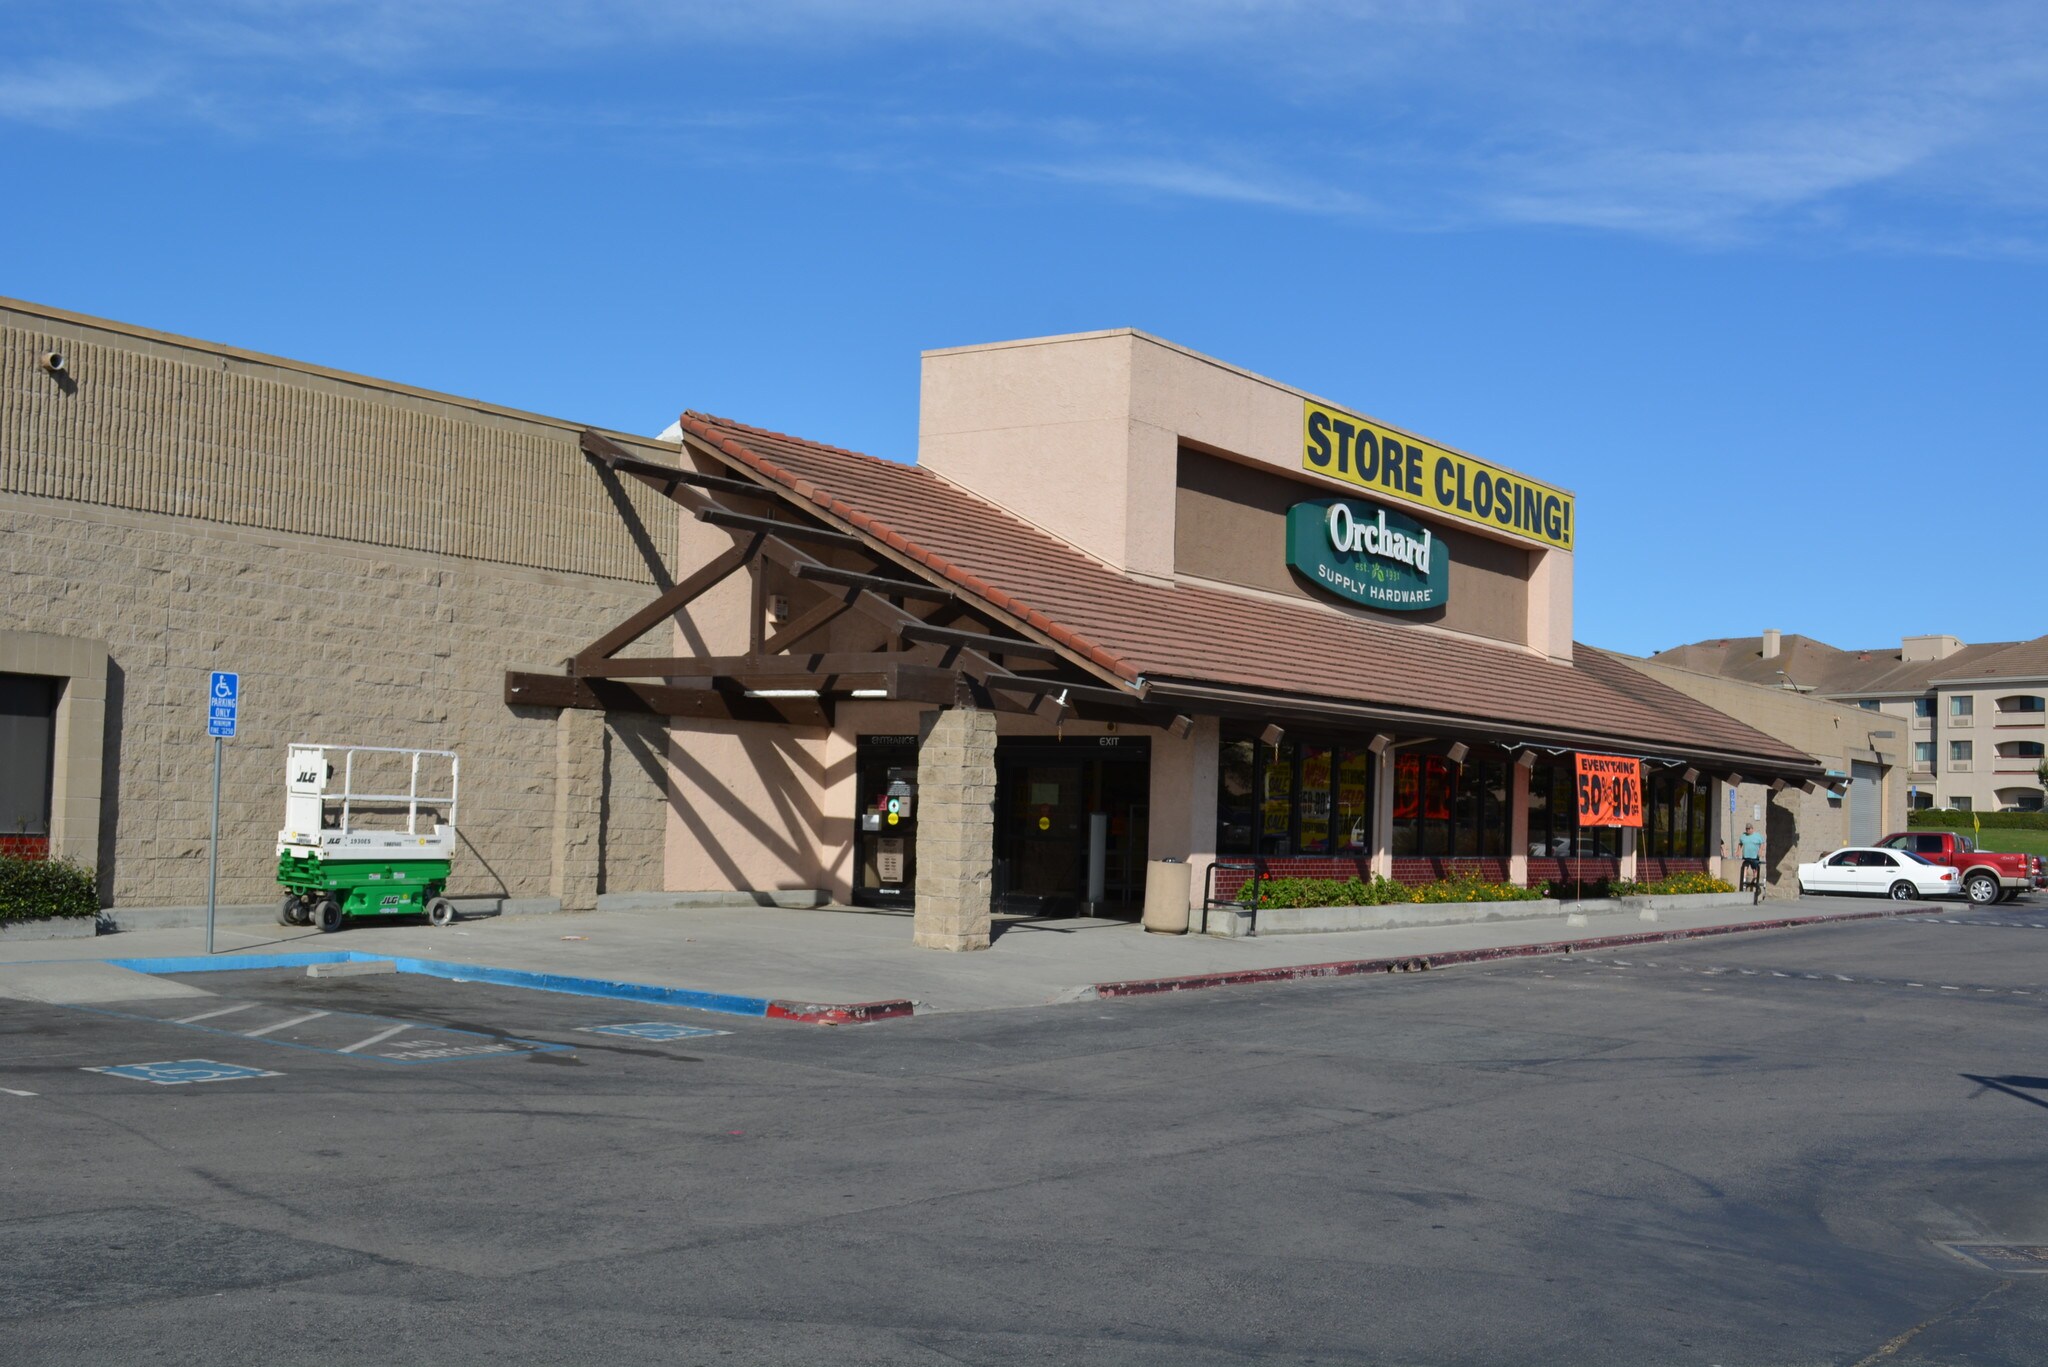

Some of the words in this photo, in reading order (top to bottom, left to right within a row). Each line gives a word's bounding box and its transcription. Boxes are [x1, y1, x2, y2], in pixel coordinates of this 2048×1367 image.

[1306, 410, 1424, 498] STORE
[1434, 456, 1571, 544] CLOSING!
[1329, 502, 1431, 576] Orchard
[1318, 563, 1366, 596] SUPPLY
[1370, 585, 1431, 603] HARDWARE
[211, 697, 236, 708] PARKING
[215, 707, 231, 718] ONLY
[872, 736, 915, 745] ENTRANCE
[1099, 737, 1120, 746] EXIT
[1581, 759, 1635, 775] EVERYTHING
[296, 772, 317, 783] JLG
[382, 896, 399, 905] JLG
